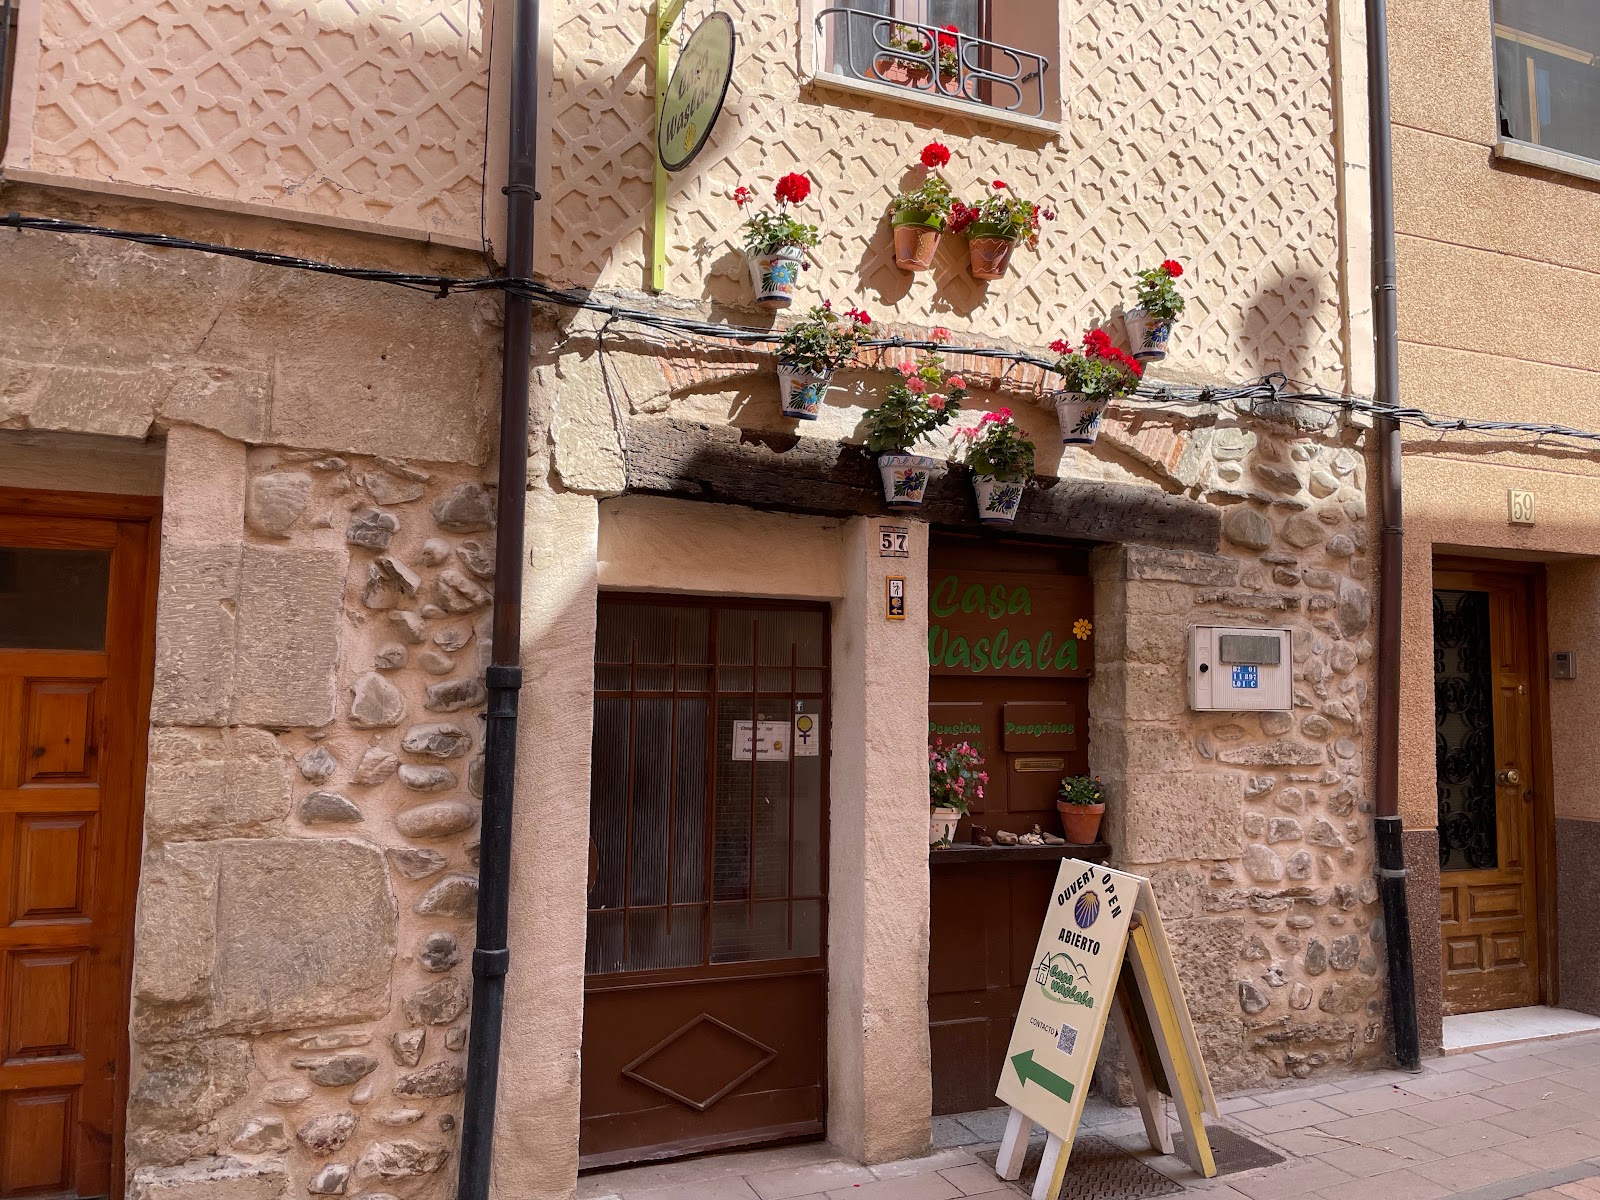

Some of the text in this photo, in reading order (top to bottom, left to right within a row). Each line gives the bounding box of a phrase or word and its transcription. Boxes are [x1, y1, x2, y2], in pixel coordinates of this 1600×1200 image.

[1513, 493, 1533, 520] 59
[882, 533, 907, 551] 57
[931, 575, 1032, 619] Casa
[1005, 721, 1075, 738] Peregrinos
[1057, 866, 1095, 907] OUVERT
[1101, 873, 1122, 919] OPEN
[1058, 927, 1101, 956] ABIERTO
[1049, 964, 1074, 986] Casa
[1029, 1016, 1055, 1036] CONTACTO
